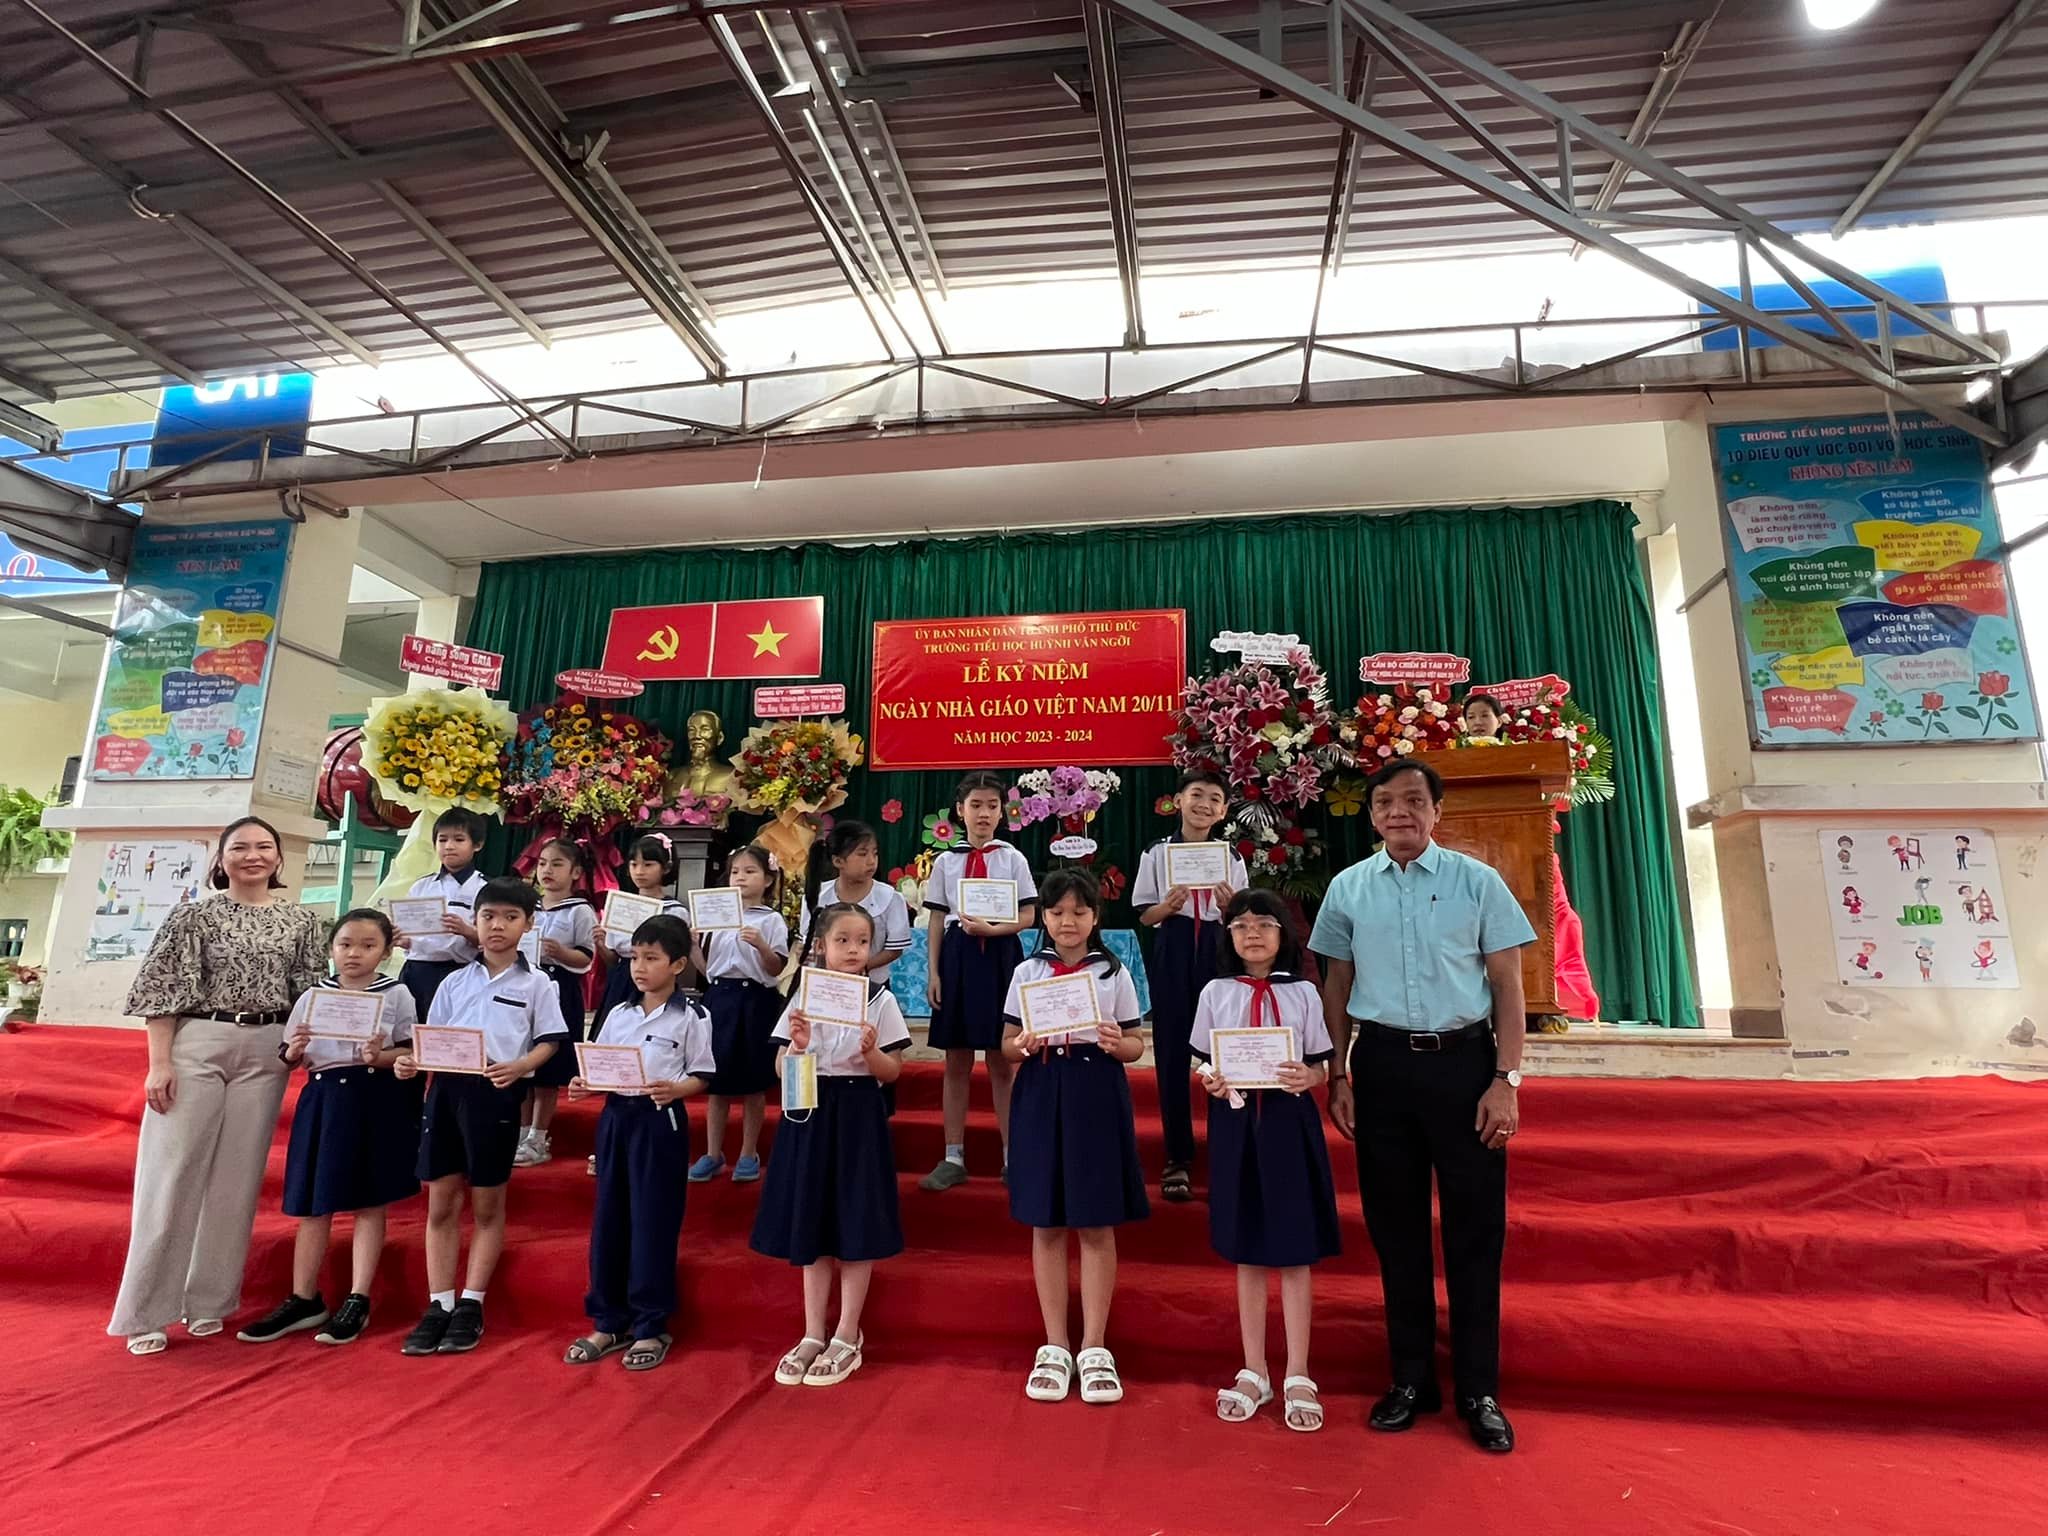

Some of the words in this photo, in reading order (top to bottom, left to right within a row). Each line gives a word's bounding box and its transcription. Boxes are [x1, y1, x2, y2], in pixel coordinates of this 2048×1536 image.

[1727, 450, 1743, 463] 10
[933, 628, 955, 639] BAN
[958, 626, 991, 638] NHÂN
[1062, 621, 1086, 634] PHỐ
[1088, 620, 1113, 633] THỦ
[1115, 619, 1140, 632] ĐỨC
[924, 641, 970, 655] TRƯỜNG
[974, 638, 1000, 652] TIỂU
[1003, 641, 1028, 653] HỌC
[1074, 636, 1098, 648] VĂN
[963, 658, 991, 683] LỄ
[996, 658, 1026, 682] KỶ
[1032, 658, 1089, 685] NIỆM
[880, 697, 932, 720] NGÀY
[936, 695, 975, 718] NHÀ
[980, 694, 1029, 718] GIÁO
[1033, 692, 1078, 719] VIỆT
[1082, 696, 1127, 714] NAM
[1131, 695, 1173, 713] 20/11
[954, 729, 986, 745] NĂM
[990, 731, 1022, 746] HỌC
[1025, 730, 1053, 743] 2023
[1064, 729, 1093, 742] 2024
[1896, 904, 1944, 927] JOB
